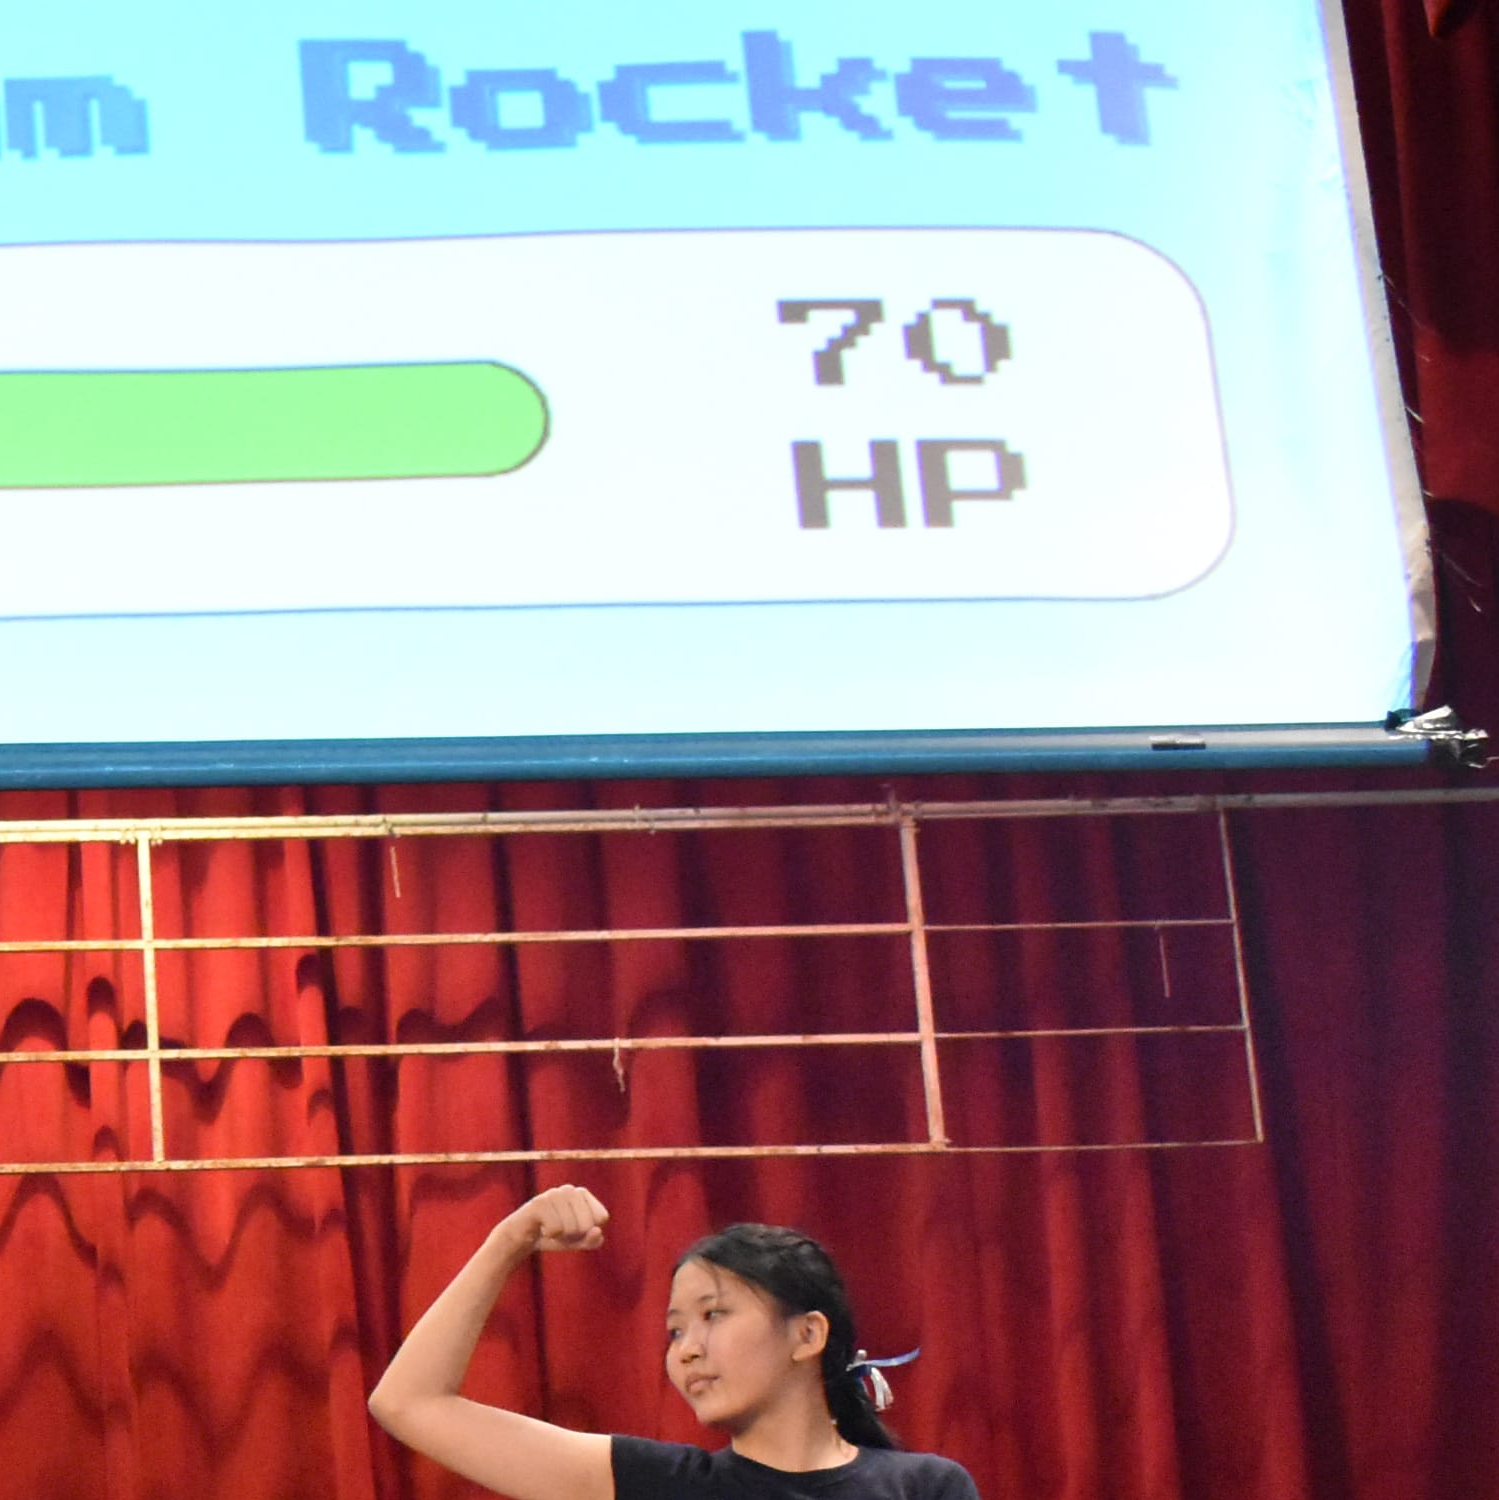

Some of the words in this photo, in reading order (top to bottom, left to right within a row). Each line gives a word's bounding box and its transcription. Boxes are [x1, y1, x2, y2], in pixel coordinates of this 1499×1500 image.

[298, 31, 1179, 154] Rocket
[776, 298, 1012, 386] 70
[790, 438, 1028, 529] HP
